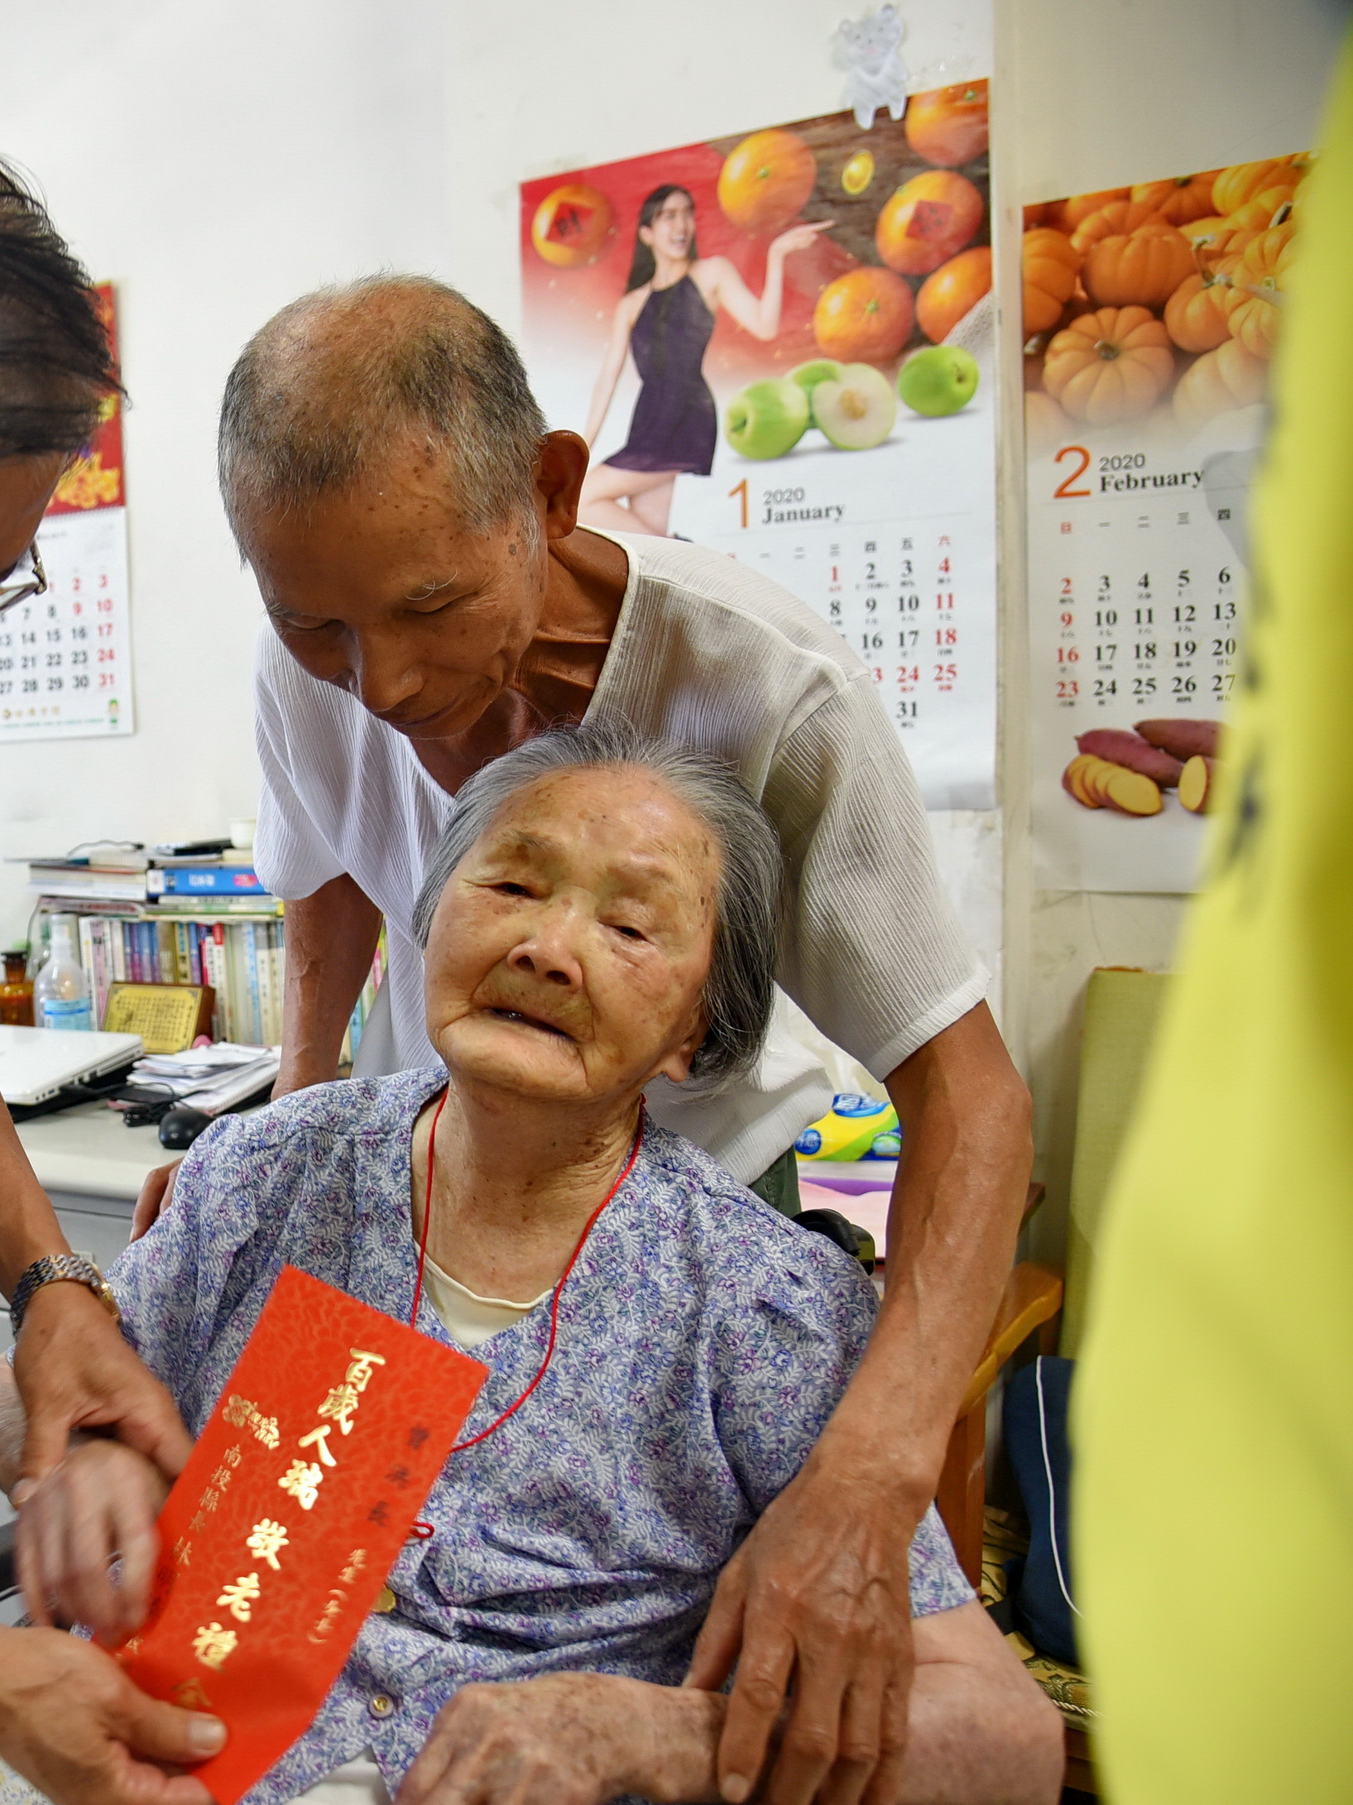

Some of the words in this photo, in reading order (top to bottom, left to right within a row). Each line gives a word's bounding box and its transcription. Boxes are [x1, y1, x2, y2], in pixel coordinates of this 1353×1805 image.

[1053, 445, 1091, 499] 2
[1099, 453, 1146, 472] 2020
[1100, 469, 1204, 493] February
[728, 479, 749, 528] 1
[763, 487, 805, 505] 2020
[762, 504, 845, 524] January
[831, 565, 839, 582] 1
[865, 562, 876, 580] 2
[901, 559, 913, 578] 3
[938, 556, 950, 573] 4
[73, 577, 81, 591] 2
[99, 575, 108, 588] 3
[1061, 577, 1072, 595] 2
[1098, 574, 1110, 593] 3
[1137, 571, 1150, 588] 4
[1178, 569, 1190, 588] 5
[1218, 565, 1231, 584] 6
[23, 608, 31, 620] 7
[48, 605, 56, 617] 8
[73, 602, 82, 615] 9
[98, 599, 113, 612] 10
[829, 600, 841, 617] 8
[865, 597, 877, 613] 9
[899, 594, 919, 612] 10
[936, 592, 954, 610] 11
[1061, 611, 1073, 628] 9
[1095, 609, 1117, 627] 10
[1135, 607, 1154, 624] 11
[1173, 604, 1196, 622] 12
[1214, 602, 1236, 620] 13
[22, 632, 36, 644] 14
[47, 629, 61, 642] 15
[72, 627, 87, 640] 16
[98, 623, 113, 637] 17
[862, 631, 883, 650] 16
[898, 630, 919, 647] 17
[936, 628, 957, 645] 18
[21, 656, 36, 669] 21
[46, 653, 62, 667] 22
[71, 651, 88, 664] 23
[98, 649, 114, 662] 24
[1057, 646, 1079, 664] 16
[1095, 644, 1117, 661] 17
[1134, 642, 1157, 660] 18
[1173, 640, 1196, 657] 19
[1211, 637, 1236, 656] 20
[22, 680, 38, 693] 28
[47, 678, 63, 690] 29
[72, 675, 89, 689] 30
[99, 673, 115, 686] 31
[872, 667, 883, 683] 3
[897, 665, 919, 682] 24
[934, 663, 957, 681] 25
[1056, 681, 1079, 698] 23
[1094, 679, 1117, 696] 24
[1132, 677, 1157, 694] 25
[1171, 675, 1196, 693] 26
[1211, 674, 1236, 691] 27
[896, 701, 917, 718] 31
